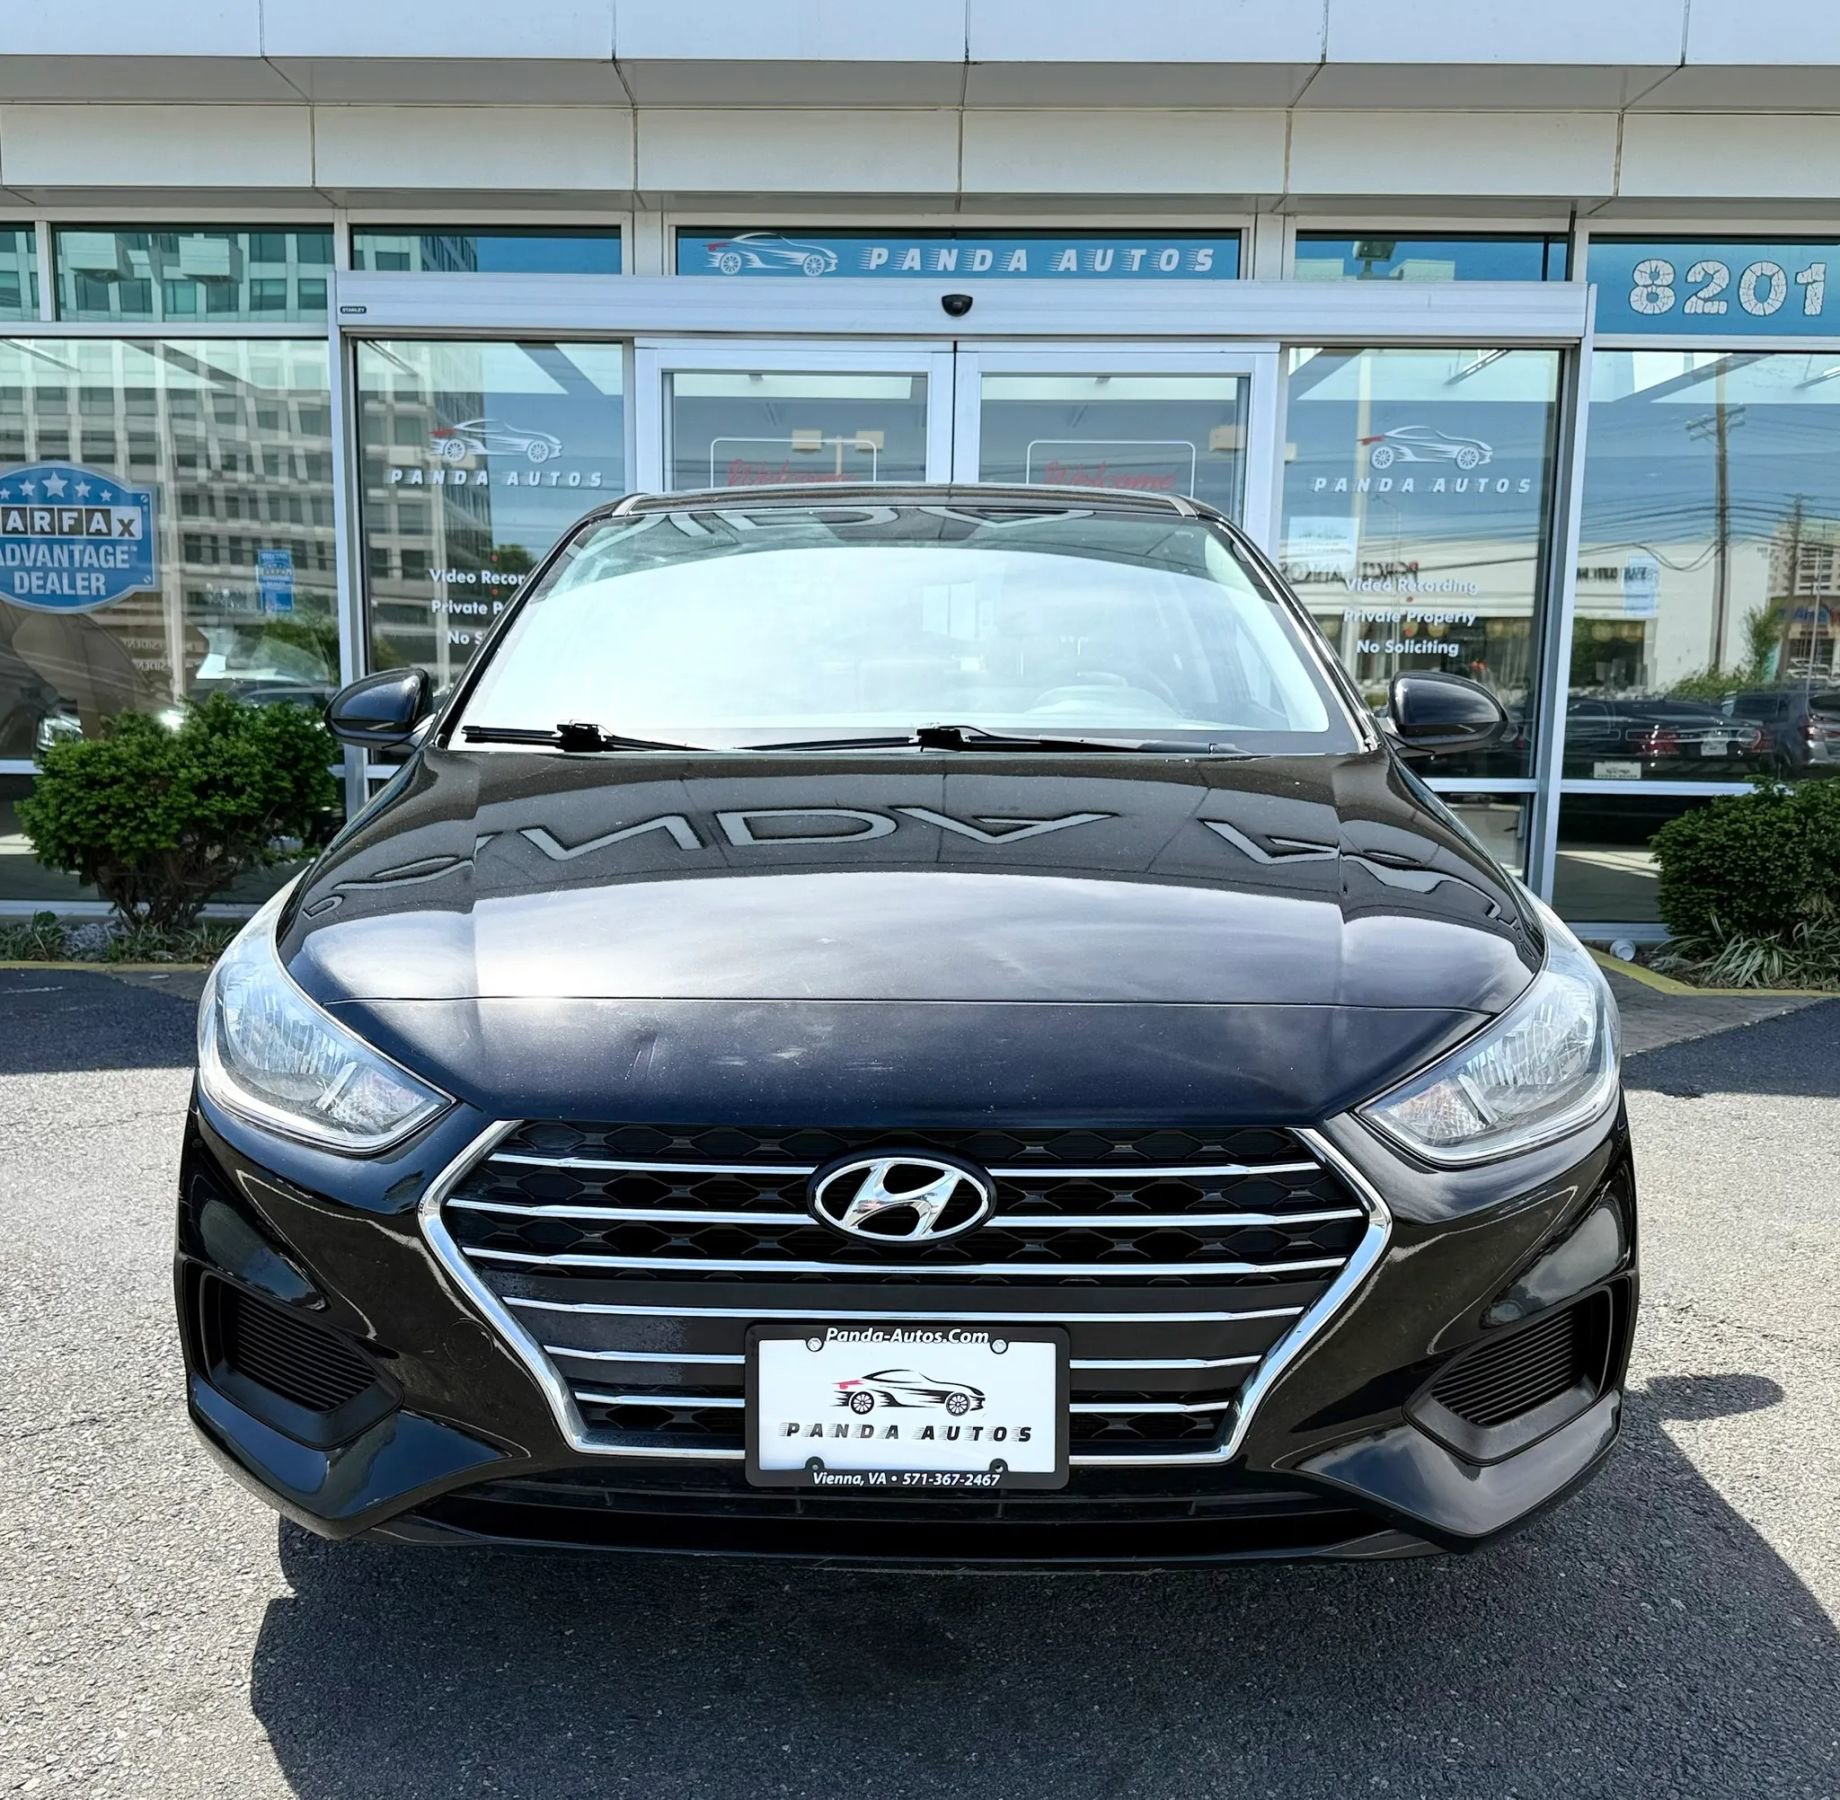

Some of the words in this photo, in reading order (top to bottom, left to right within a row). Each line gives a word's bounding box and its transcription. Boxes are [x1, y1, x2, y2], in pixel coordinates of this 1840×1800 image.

[860, 247, 1027, 272] PANDA
[1051, 248, 1214, 272] AUTOS
[1629, 258, 1827, 316] 8201
[391, 470, 489, 485] PANDA
[507, 471, 602, 486] AUTOS
[1314, 477, 1414, 493] PANDA
[1433, 478, 1531, 493] AUTOS
[5, 510, 136, 538] ARFAX
[14, 571, 106, 596] DEALER
[429, 569, 476, 584] Video
[481, 570, 526, 585] Recor
[1344, 577, 1393, 592] Video
[1398, 579, 1479, 596] Recording
[431, 600, 488, 615] Private
[1344, 609, 1401, 623] Private
[1406, 610, 1476, 626] Property
[448, 631, 470, 645] No
[1357, 641, 1380, 654] No
[1384, 640, 1460, 658] Soliciting
[825, 1327, 990, 1345] Panda-Autos.Com
[782, 1422, 899, 1440] PANDA
[915, 1425, 1032, 1442] AUTOS
[812, 1471, 864, 1486] Vienna,
[868, 1472, 887, 1485] VA
[902, 1472, 1000, 1486] 571-367-2467
